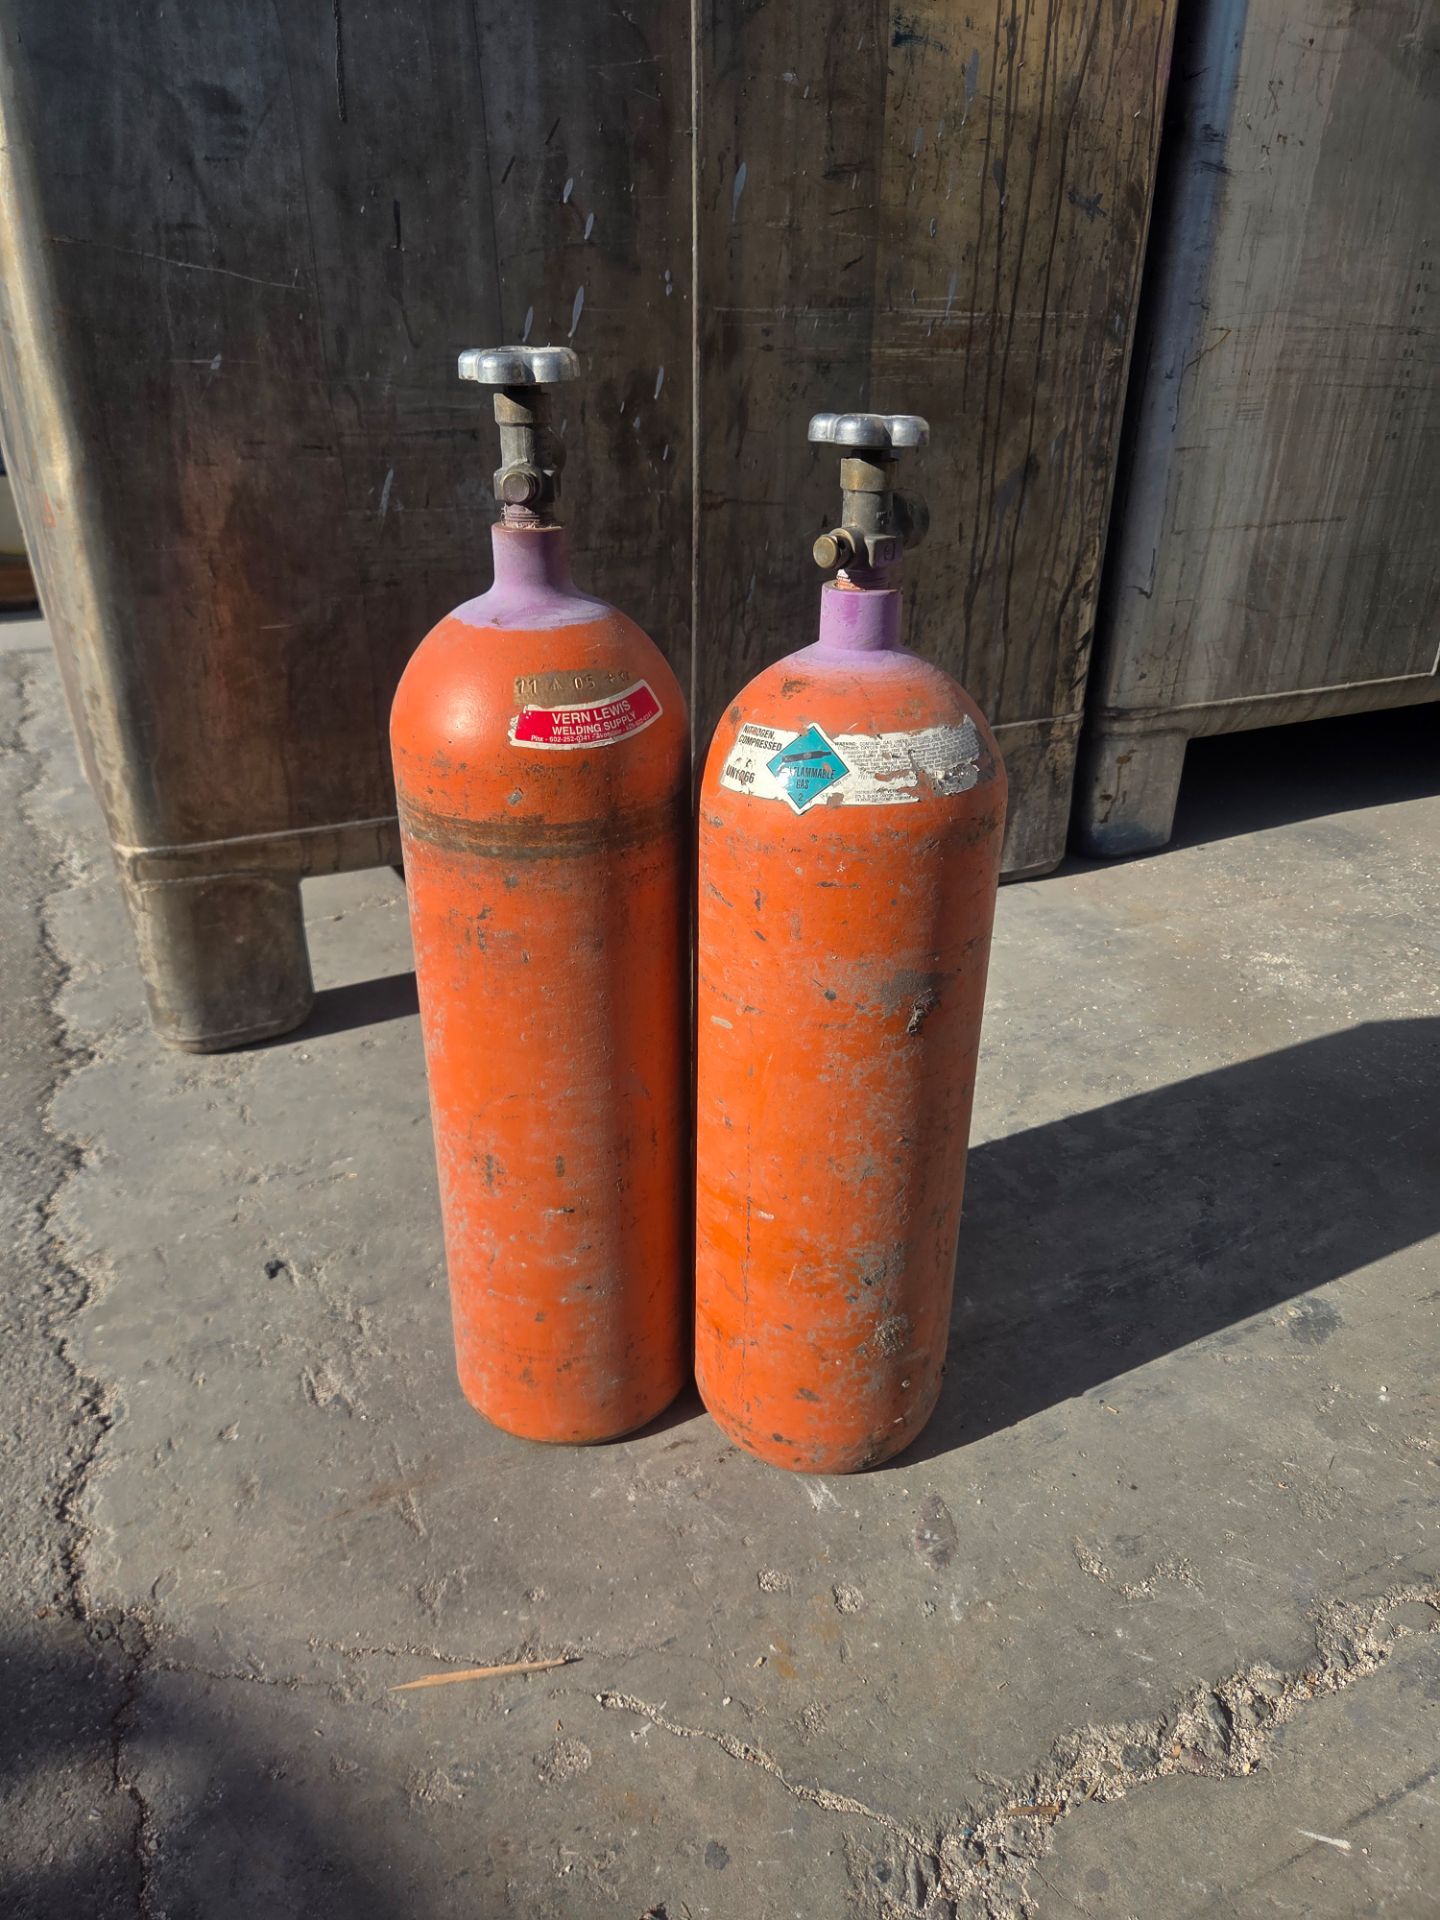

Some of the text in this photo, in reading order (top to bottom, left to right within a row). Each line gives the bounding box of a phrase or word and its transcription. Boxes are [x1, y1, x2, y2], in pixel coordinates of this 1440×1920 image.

[551, 700, 631, 725] VERN LEWIS
[551, 711, 637, 736] WELDING SUPPLY
[743, 724, 775, 741] NITROGEN,
[738, 734, 783, 751] COMPRESSED
[725, 765, 756, 784] UN1066
[796, 778, 810, 790] GAS
[797, 792, 804, 802] 2
